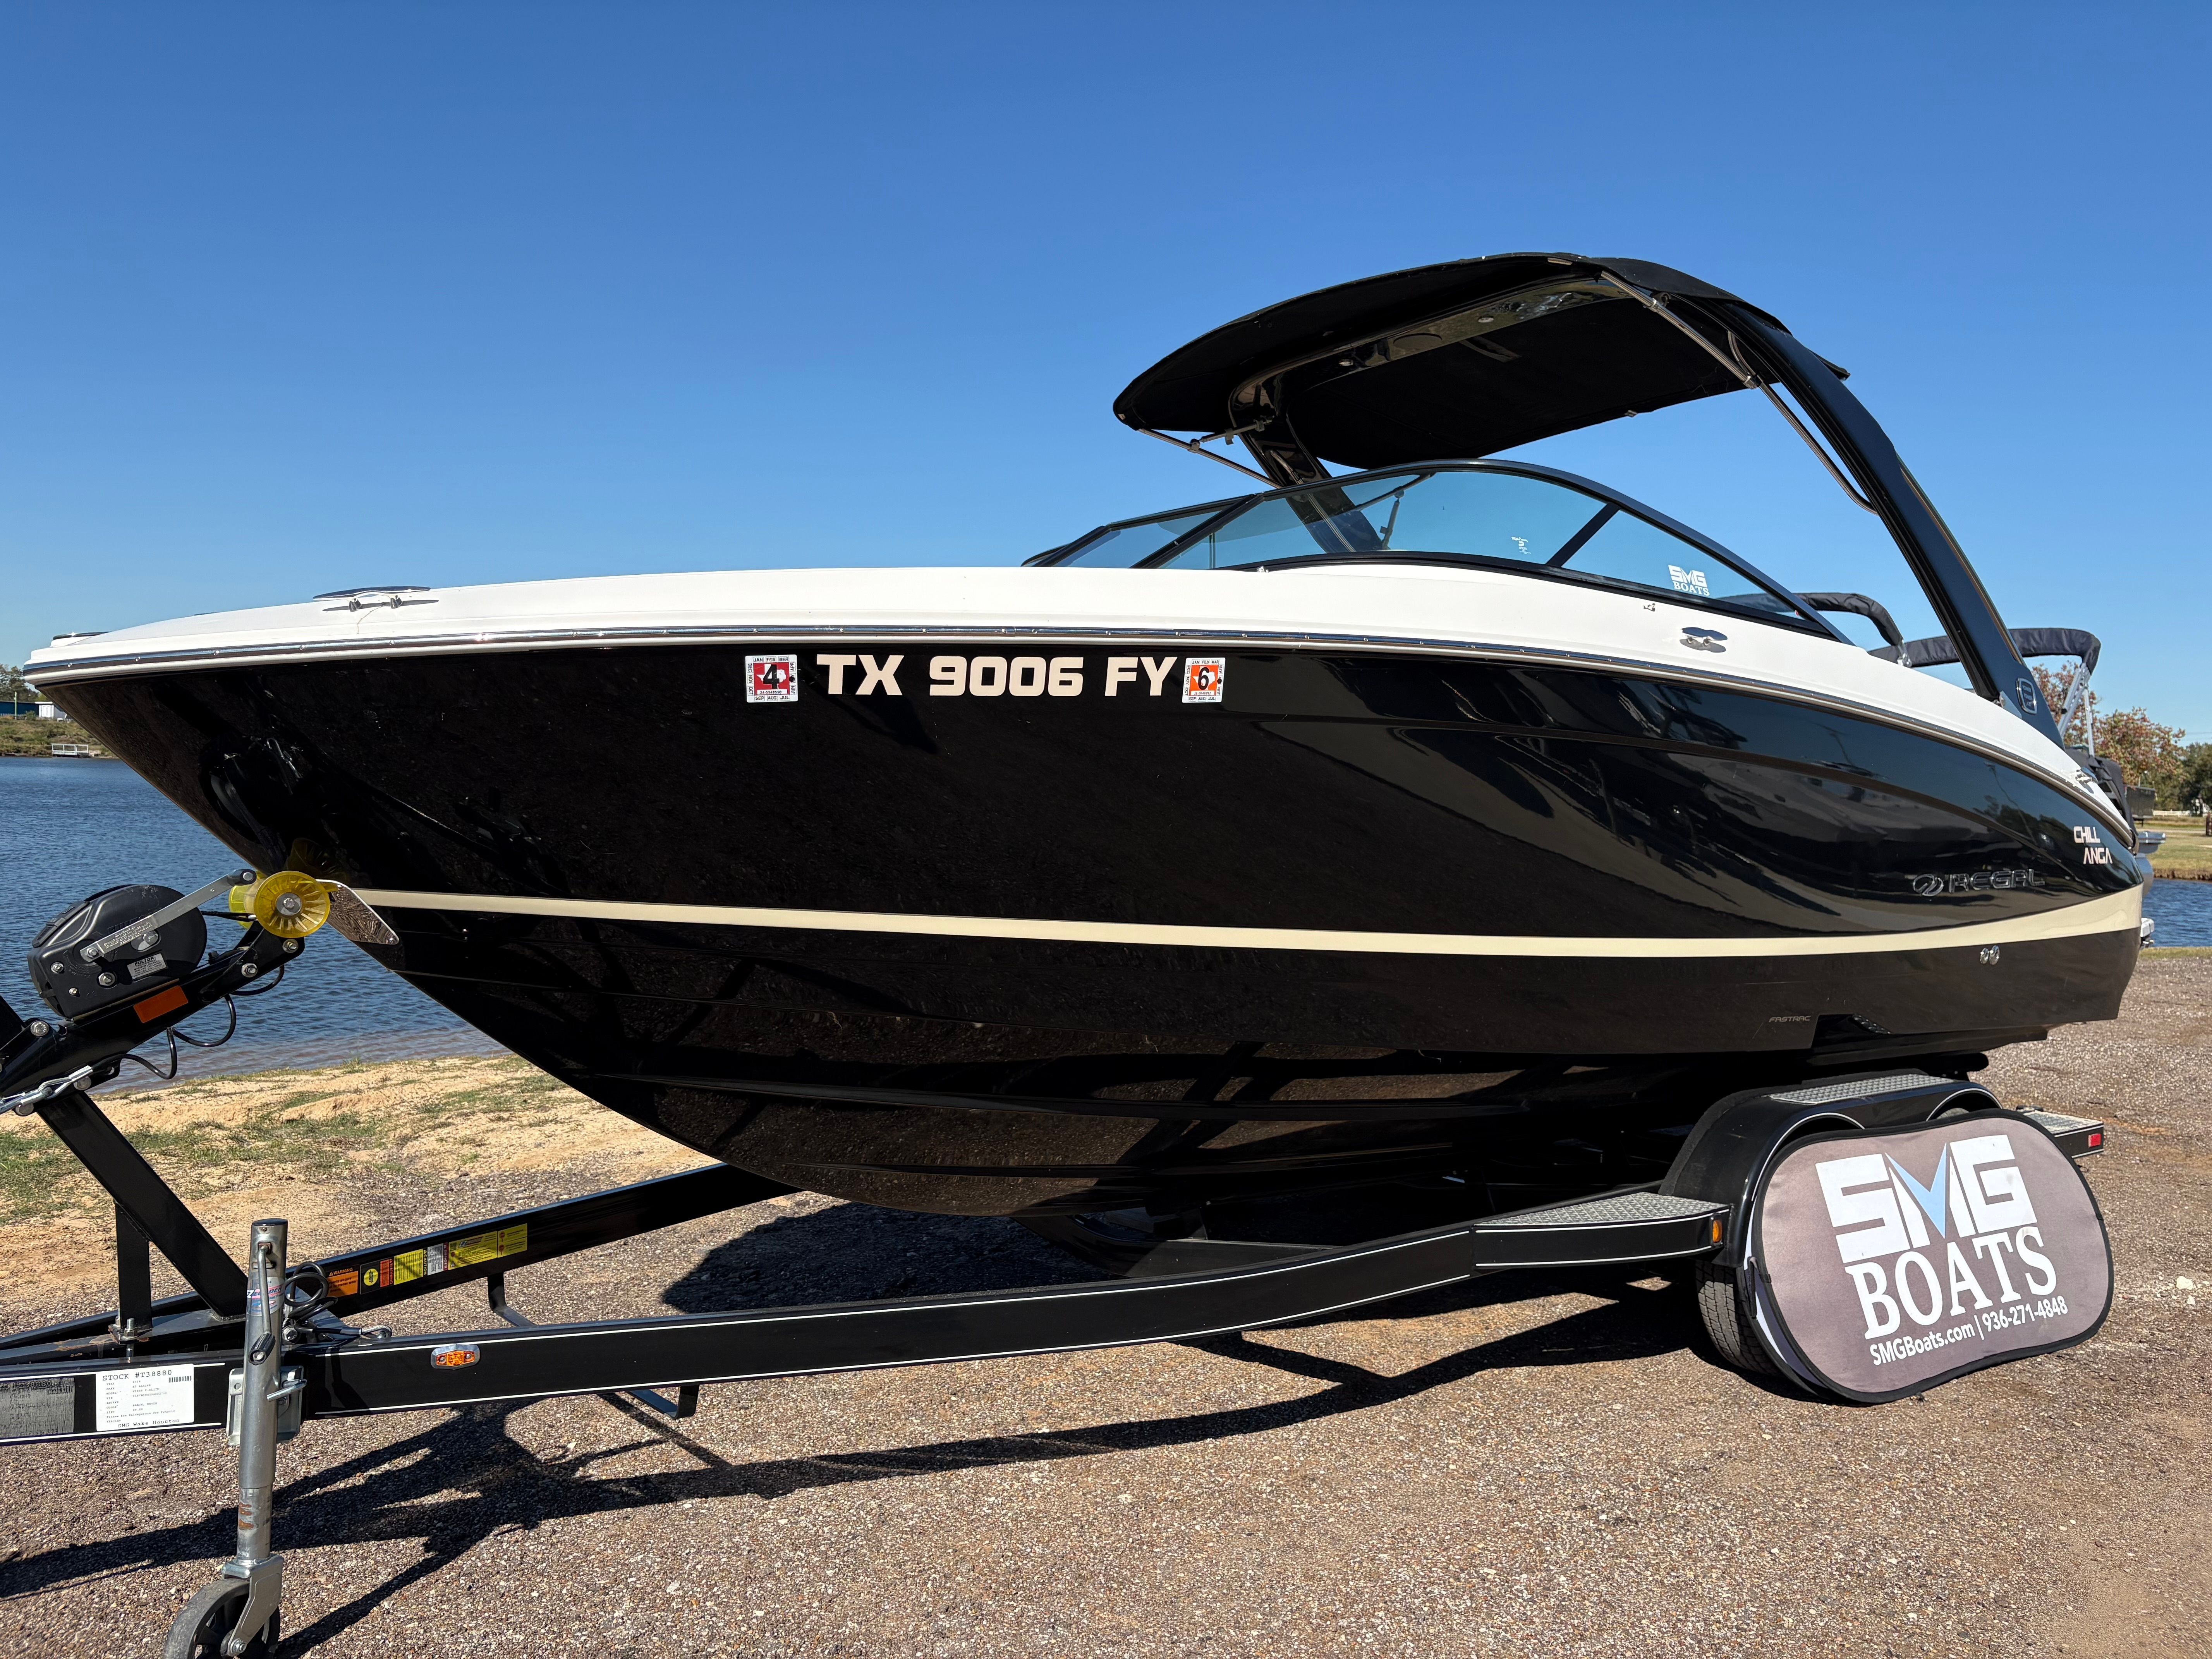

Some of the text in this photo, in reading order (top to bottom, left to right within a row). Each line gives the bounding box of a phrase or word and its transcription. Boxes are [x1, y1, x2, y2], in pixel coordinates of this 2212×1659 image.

[1668, 565, 1707, 588] SMG
[1673, 581, 1710, 596] BOATS
[763, 664, 780, 689] 4
[817, 654, 1177, 696] TX 9006 FY
[1198, 667, 1209, 690] 6
[2074, 826, 2100, 843] CHILL
[2083, 847, 2112, 864] ANGA
[1949, 869, 2045, 893] REGAL
[135, 956, 154, 966] FULTON
[1815, 1135, 2037, 1264] SMG
[1844, 1226, 2057, 1340] BOATS
[1870, 1323, 1975, 1365] SMGBoats.com
[1982, 1296, 2068, 1332] 936-271-4848
[135, 1370, 172, 1378] #T38880
